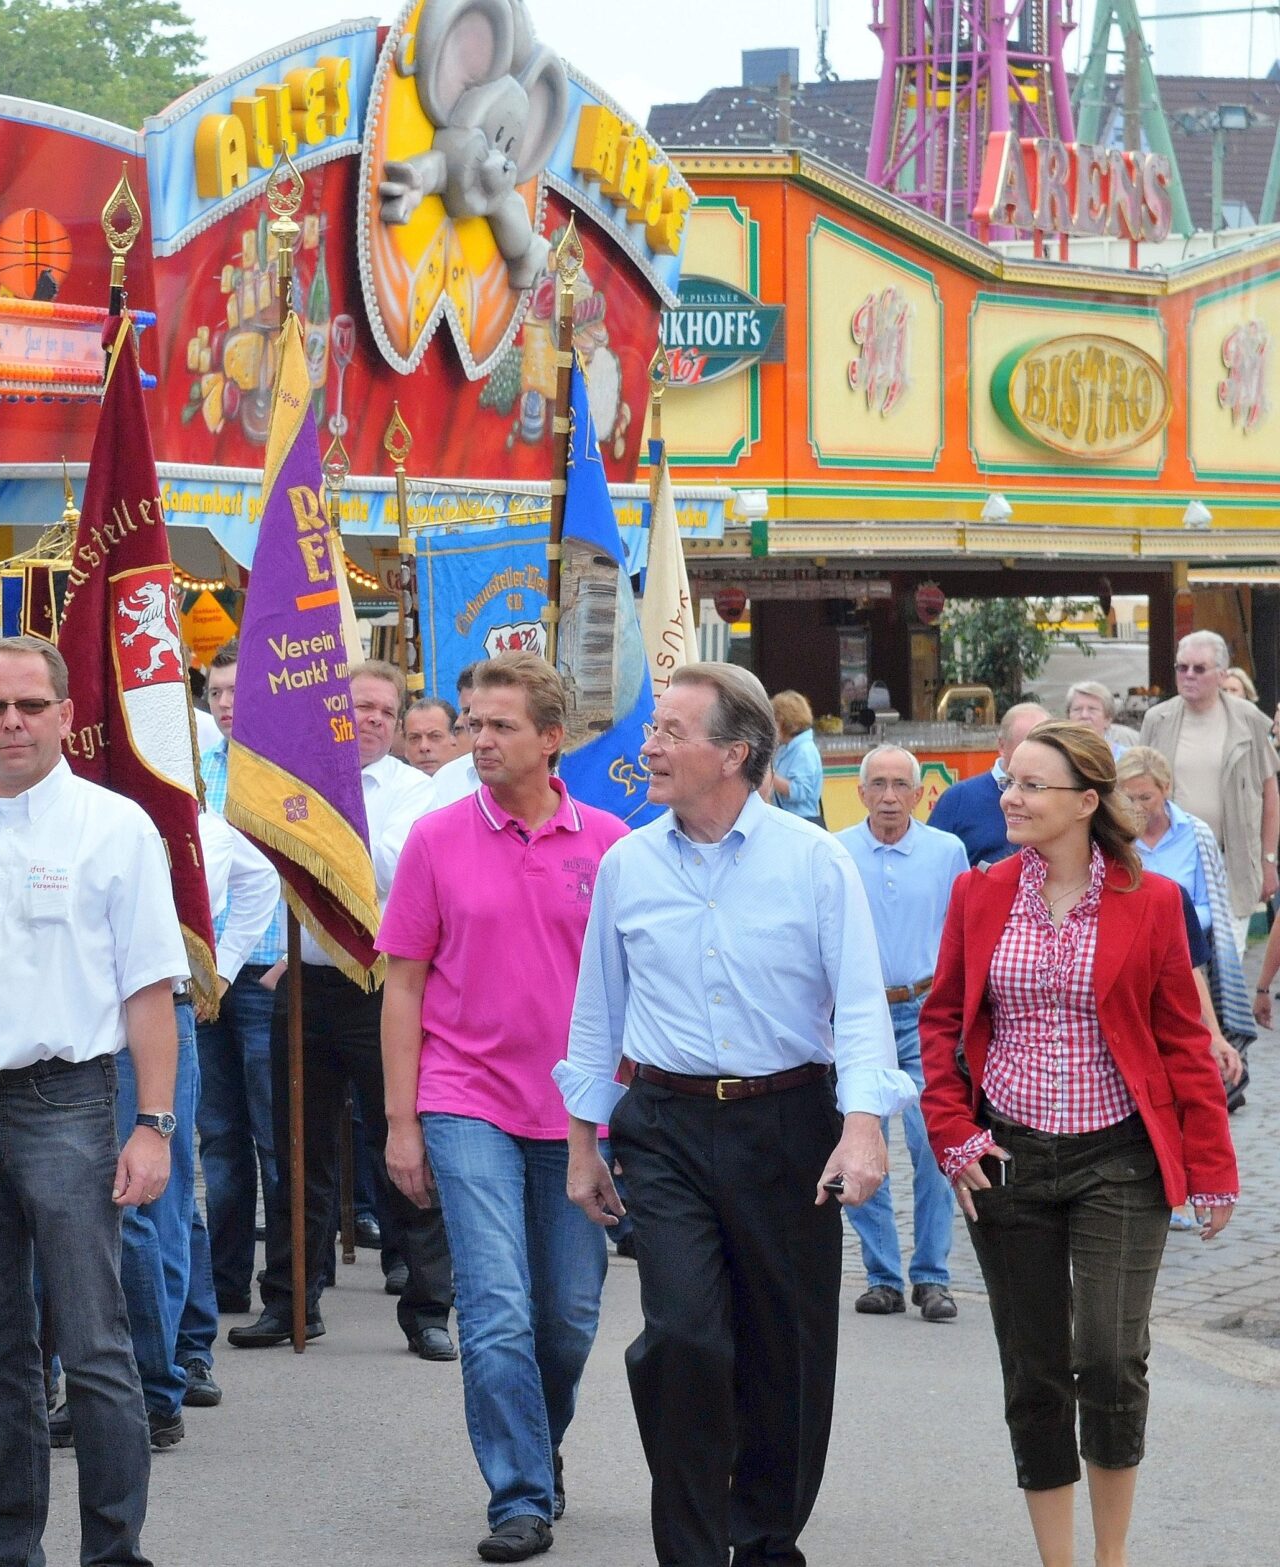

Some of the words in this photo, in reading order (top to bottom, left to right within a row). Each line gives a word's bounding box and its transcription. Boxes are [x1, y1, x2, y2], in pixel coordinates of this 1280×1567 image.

[195, 56, 351, 200] ALLES
[973, 131, 1173, 243] ARENS
[1021, 345, 1153, 446] BISTRO
[161, 481, 243, 517] Camembert
[267, 629, 336, 662] Verein
[267, 658, 329, 695] Markt
[334, 660, 351, 680] un
[322, 693, 349, 713] von
[330, 714, 356, 744] Sitz
